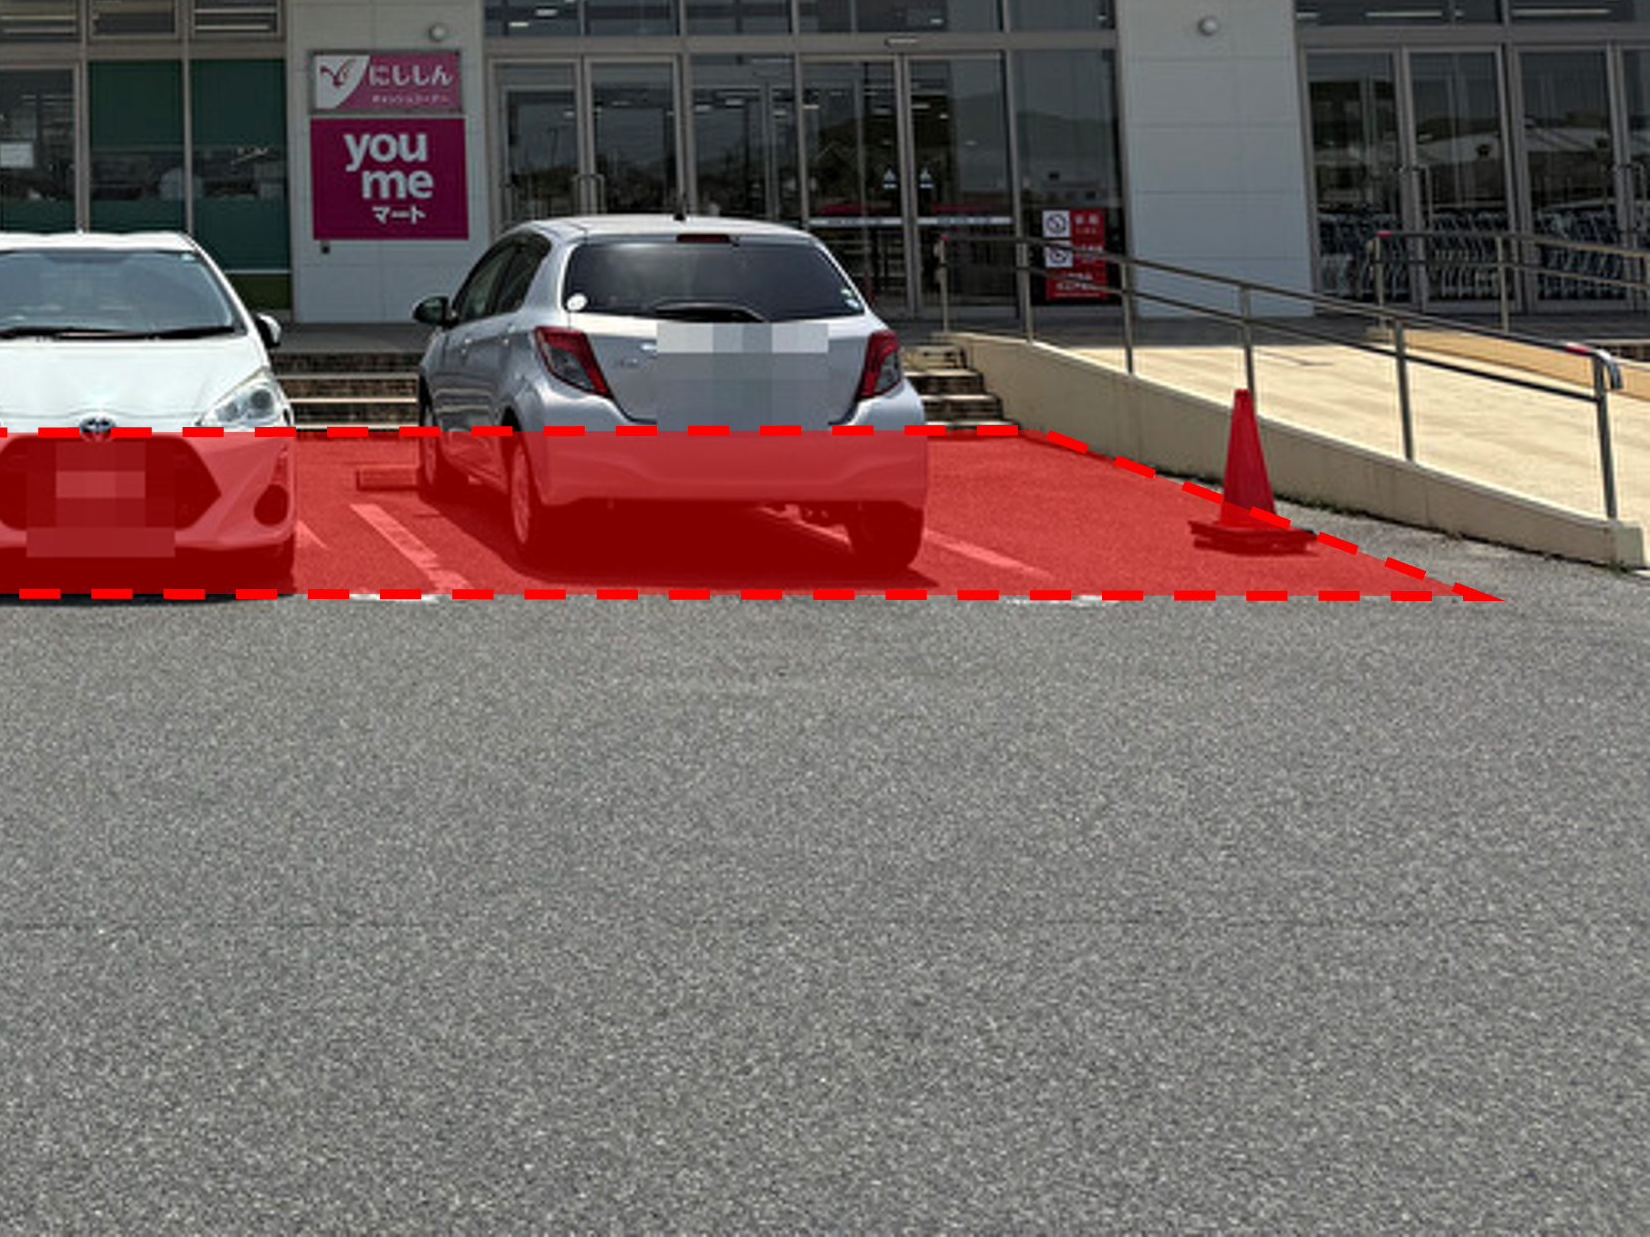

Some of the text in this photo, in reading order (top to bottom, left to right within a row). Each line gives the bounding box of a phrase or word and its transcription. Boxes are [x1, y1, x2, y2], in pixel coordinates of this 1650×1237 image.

[369, 64, 453, 87] にししん
[343, 133, 428, 173] you
[362, 169, 434, 200] me
[372, 205, 427, 225] マート
